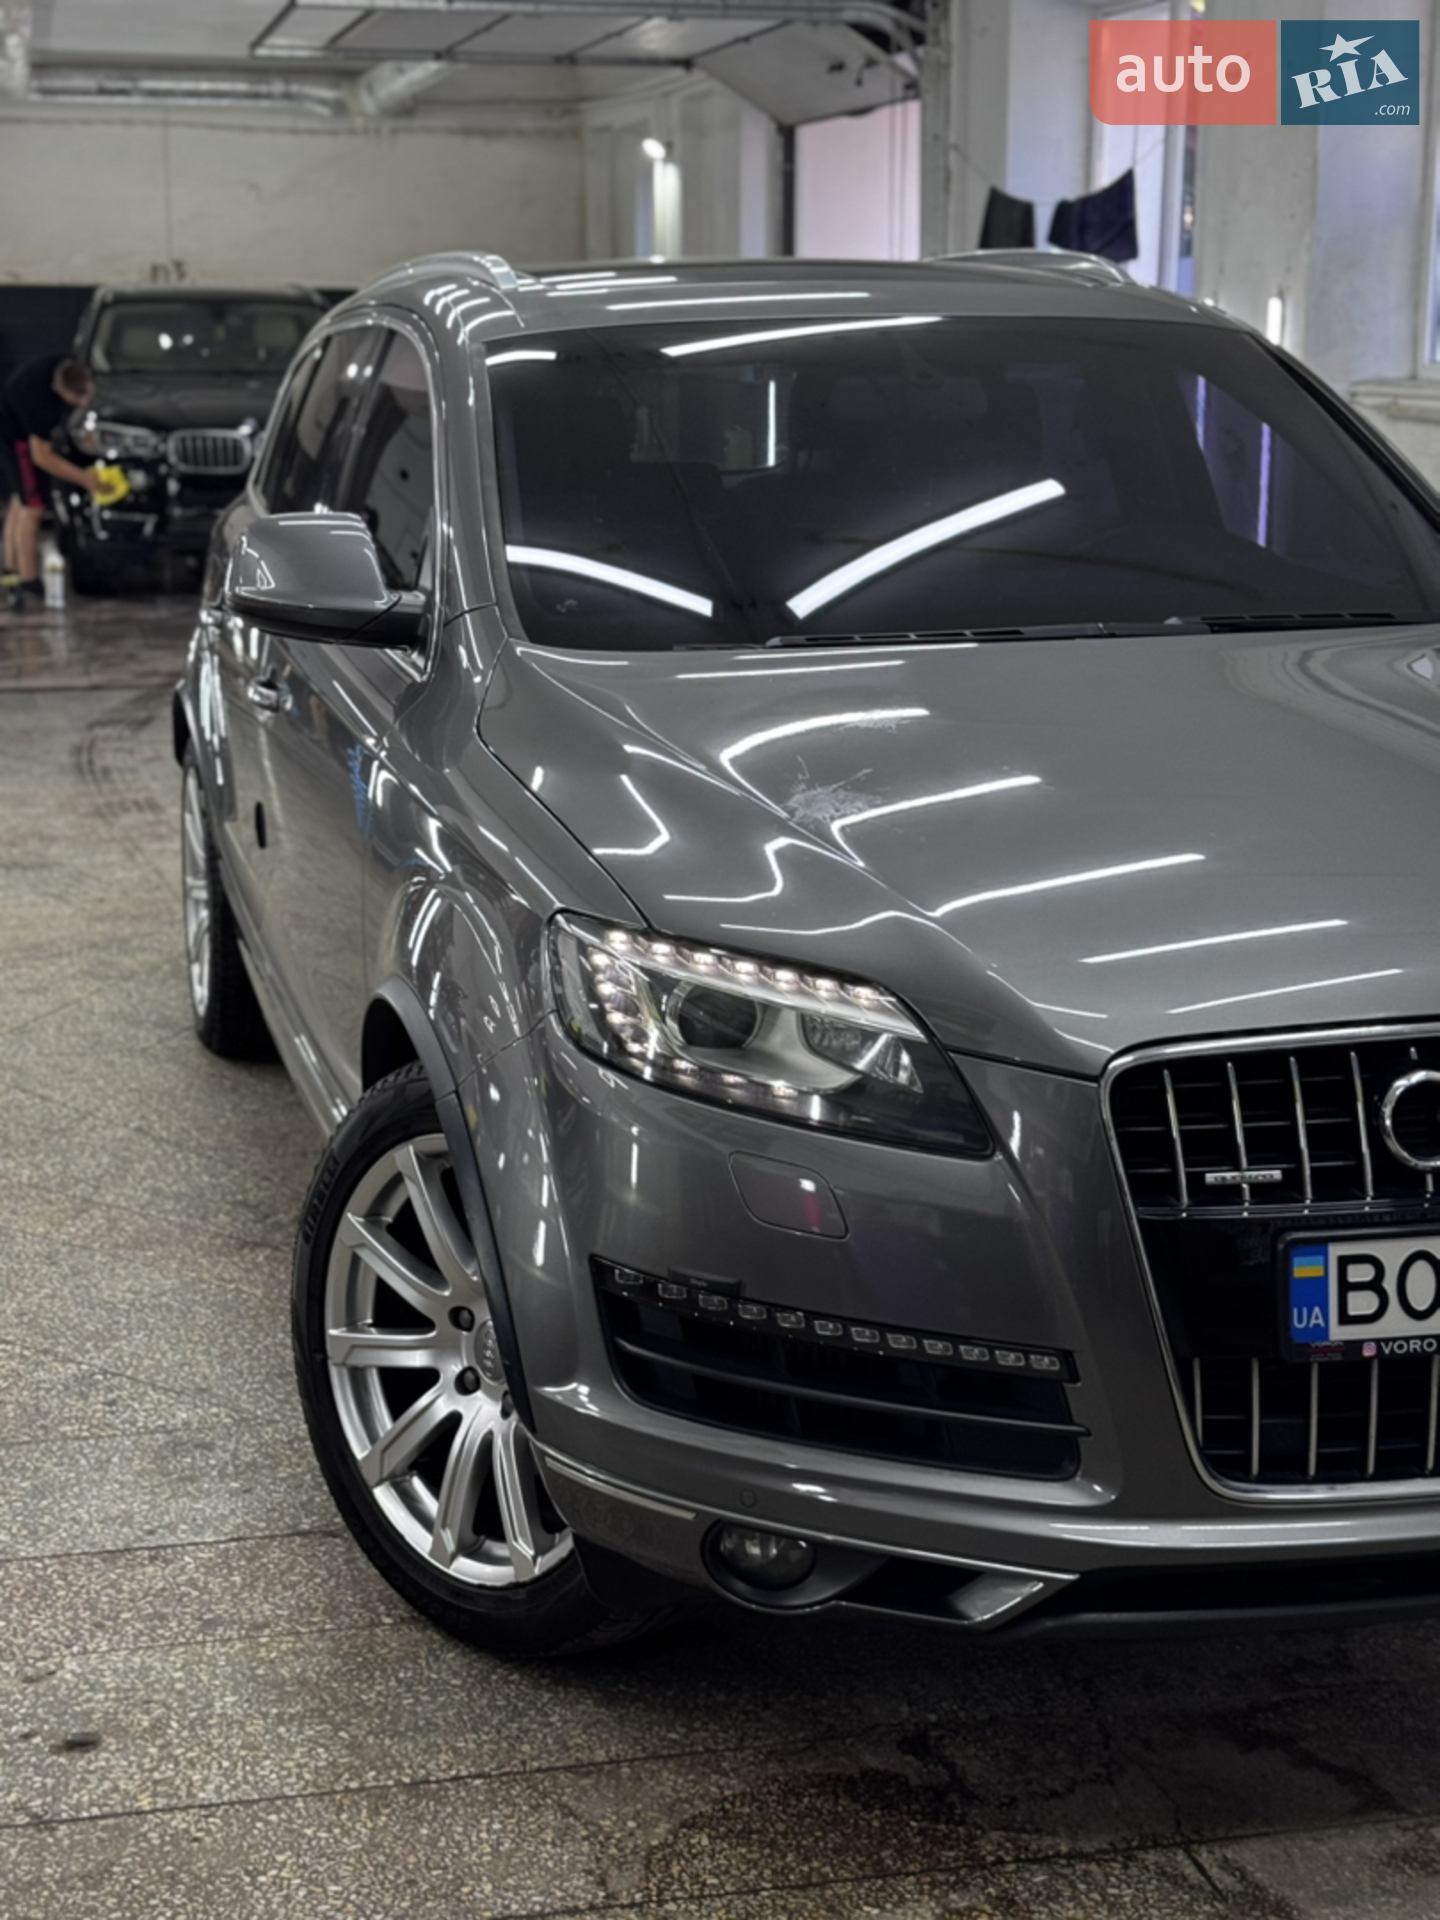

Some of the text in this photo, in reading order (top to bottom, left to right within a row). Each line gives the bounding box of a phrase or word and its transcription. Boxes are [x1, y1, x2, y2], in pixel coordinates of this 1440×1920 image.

[1337, 1249, 1440, 1326] BO
[1293, 1306, 1325, 1329] UA
[1380, 1338, 1437, 1355] VORO
